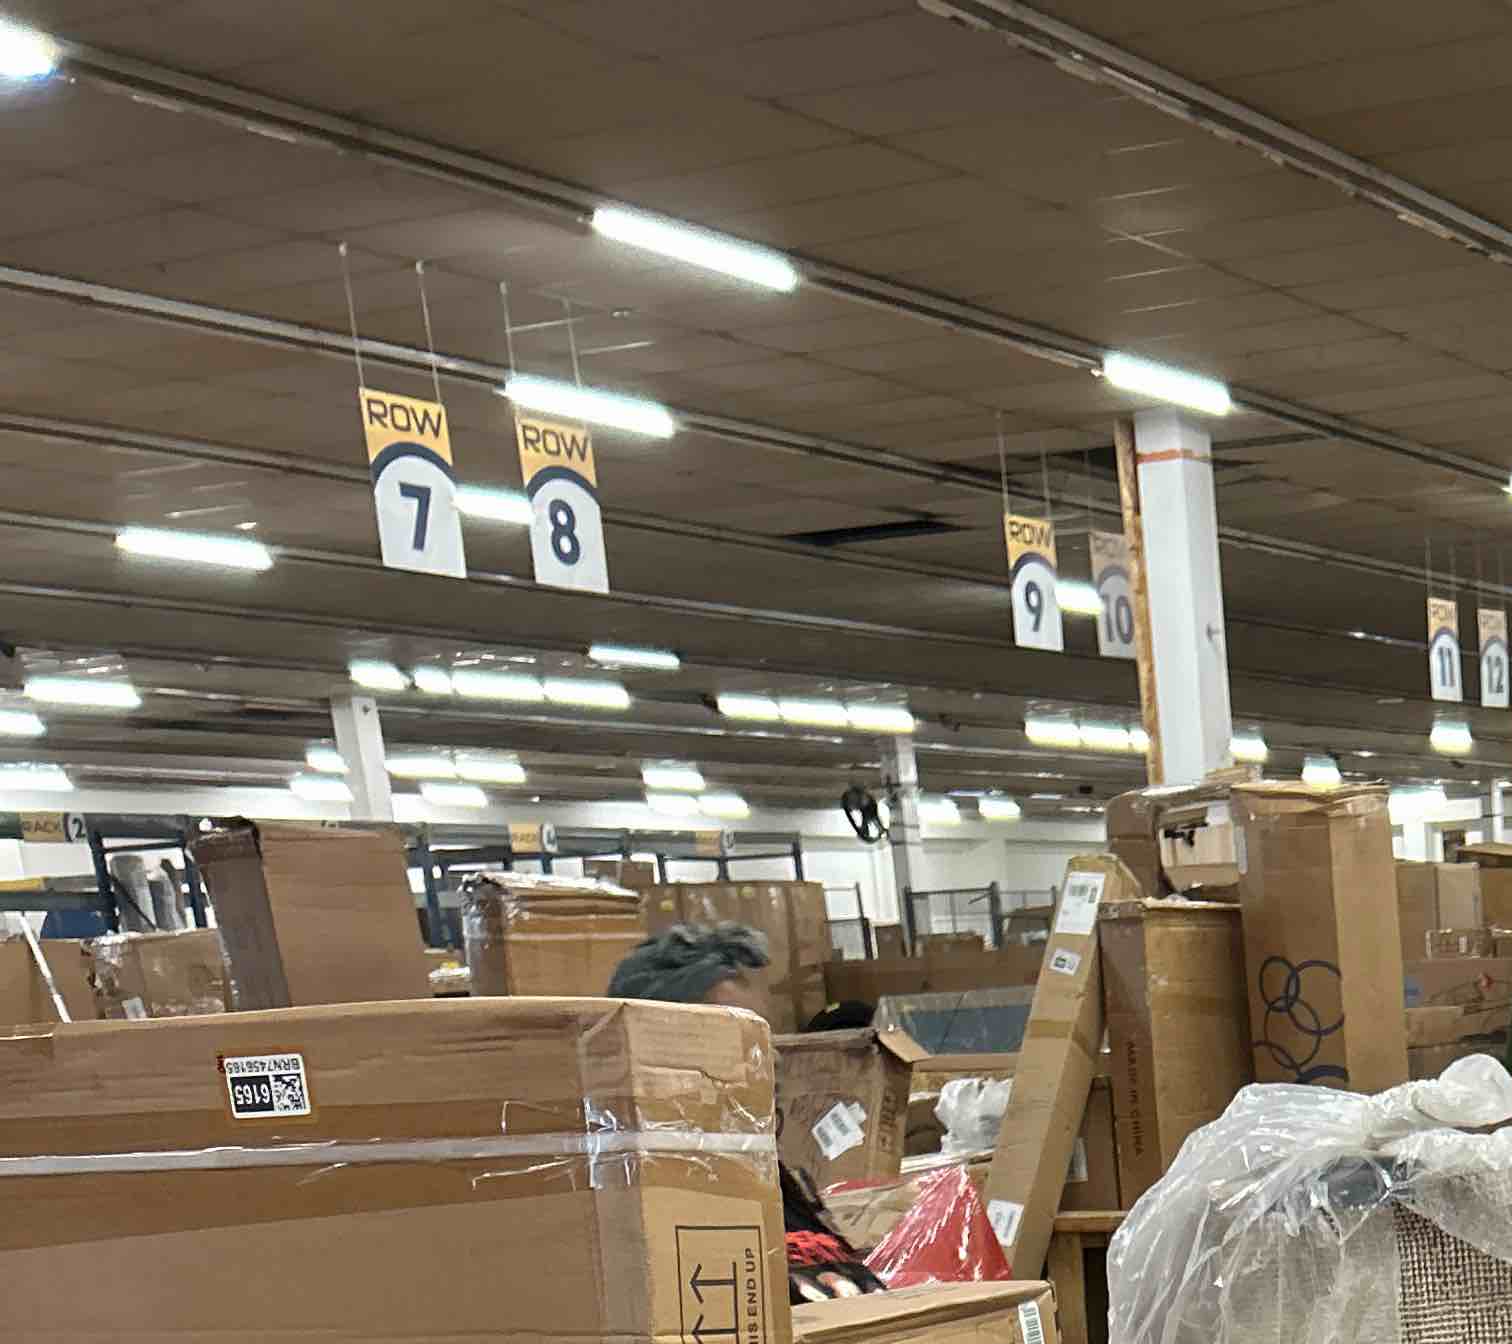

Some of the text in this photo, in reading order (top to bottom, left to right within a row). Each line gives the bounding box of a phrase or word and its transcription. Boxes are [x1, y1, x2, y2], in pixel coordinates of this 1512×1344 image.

[366, 398, 442, 438] ROW
[522, 424, 589, 462] ROW
[399, 481, 431, 552] 7
[548, 498, 581, 566] 8
[1008, 519, 1050, 547] ROW
[1024, 580, 1043, 633] 9
[1102, 593, 1136, 645] 10
[1437, 646, 1456, 688] 11
[1487, 655, 1504, 694] 12
[72, 817, 87, 839] 2
[225, 1057, 301, 1074] BRN7456165
[234, 1082, 271, 1105] 6165
[744, 1248, 757, 1272] UP
[746, 1277, 758, 1312] END
